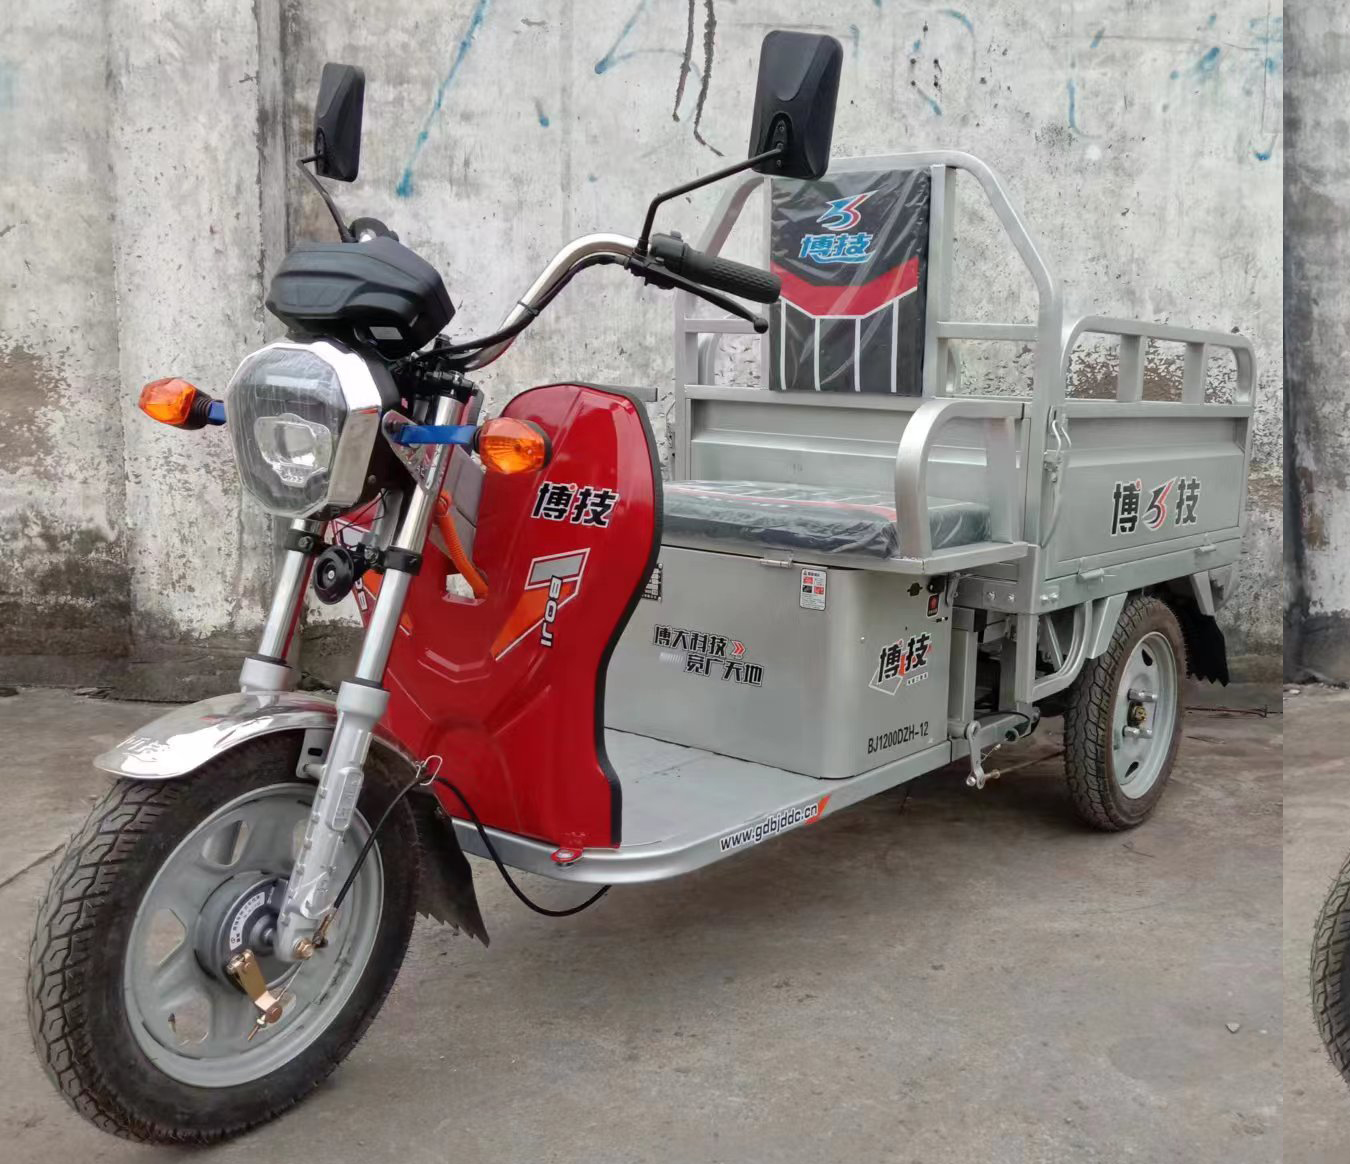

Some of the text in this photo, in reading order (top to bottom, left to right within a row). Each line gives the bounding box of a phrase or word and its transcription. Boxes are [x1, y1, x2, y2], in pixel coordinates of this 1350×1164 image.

[799, 232, 875, 263] 博技
[532, 481, 619, 527] 博技
[540, 575, 562, 647] BOJI
[654, 625, 728, 657] 博大科技
[878, 632, 932, 685] 博技
[684, 653, 764, 687] 宽广天地
[868, 721, 929, 754] BJ1200DZH-12
[720, 803, 818, 851] www.gdbjddc.cn
